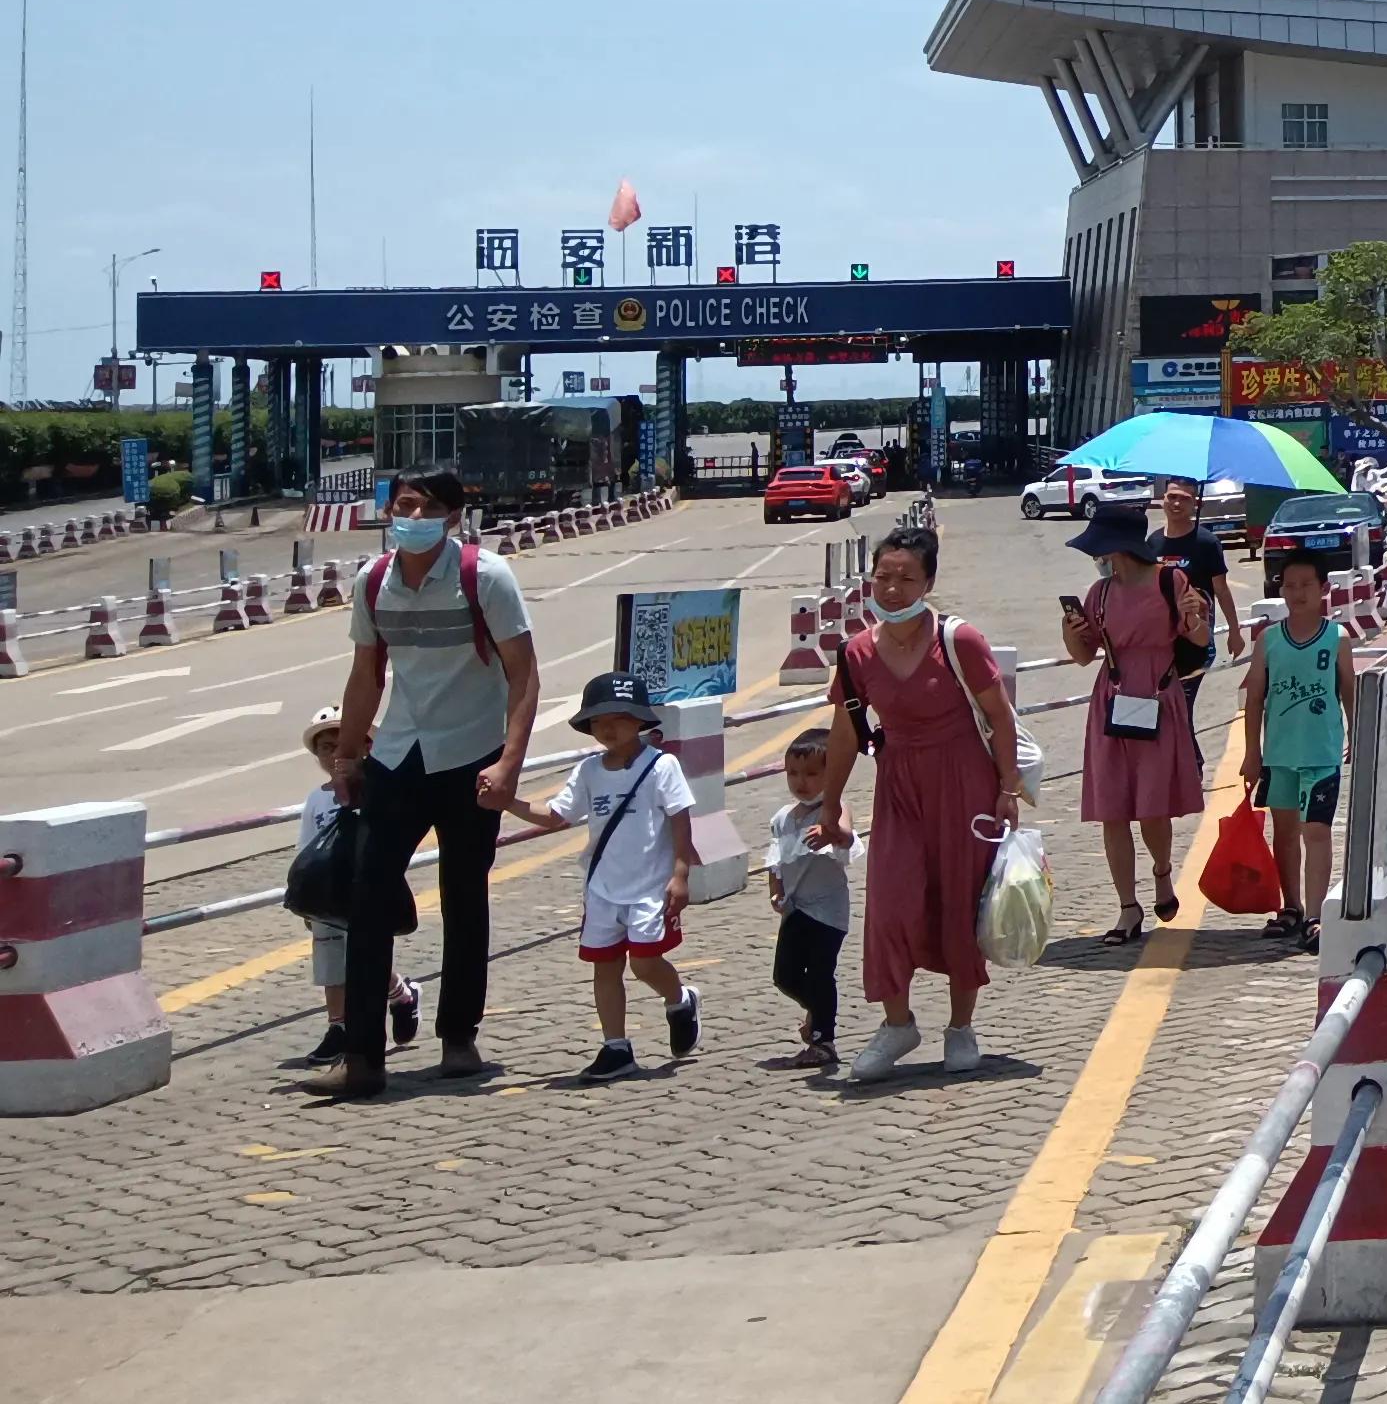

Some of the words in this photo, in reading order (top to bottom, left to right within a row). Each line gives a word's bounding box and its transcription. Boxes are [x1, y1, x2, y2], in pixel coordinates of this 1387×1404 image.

[475, 224, 781, 270] 海安新港
[446, 301, 604, 333] 公安检查
[656, 298, 731, 328] POLICE
[741, 296, 810, 325] CHECK
[1317, 649, 1331, 670] 8
